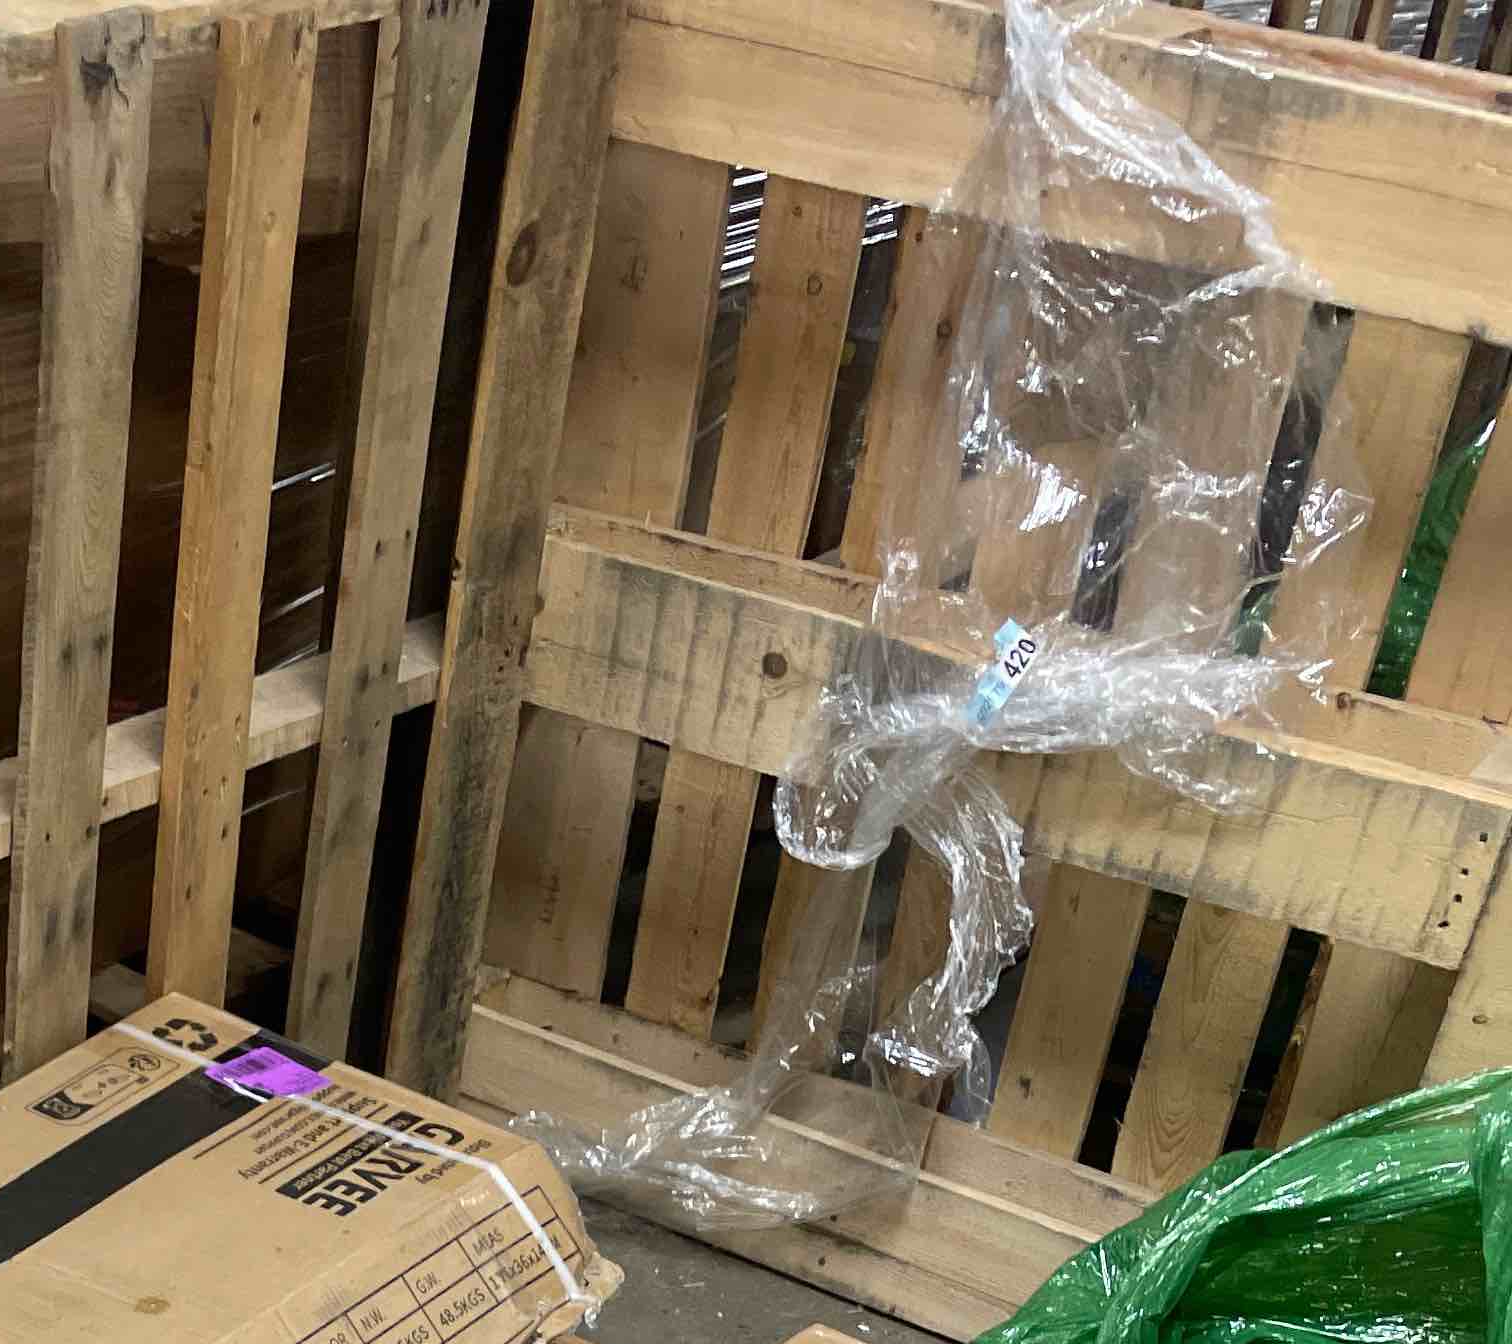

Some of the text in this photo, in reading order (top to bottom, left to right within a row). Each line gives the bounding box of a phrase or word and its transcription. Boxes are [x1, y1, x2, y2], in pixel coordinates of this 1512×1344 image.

[1004, 638, 1036, 678] 420
[414, 1271, 441, 1296] G.W.
[437, 1286, 486, 1329] 48.5KGS
